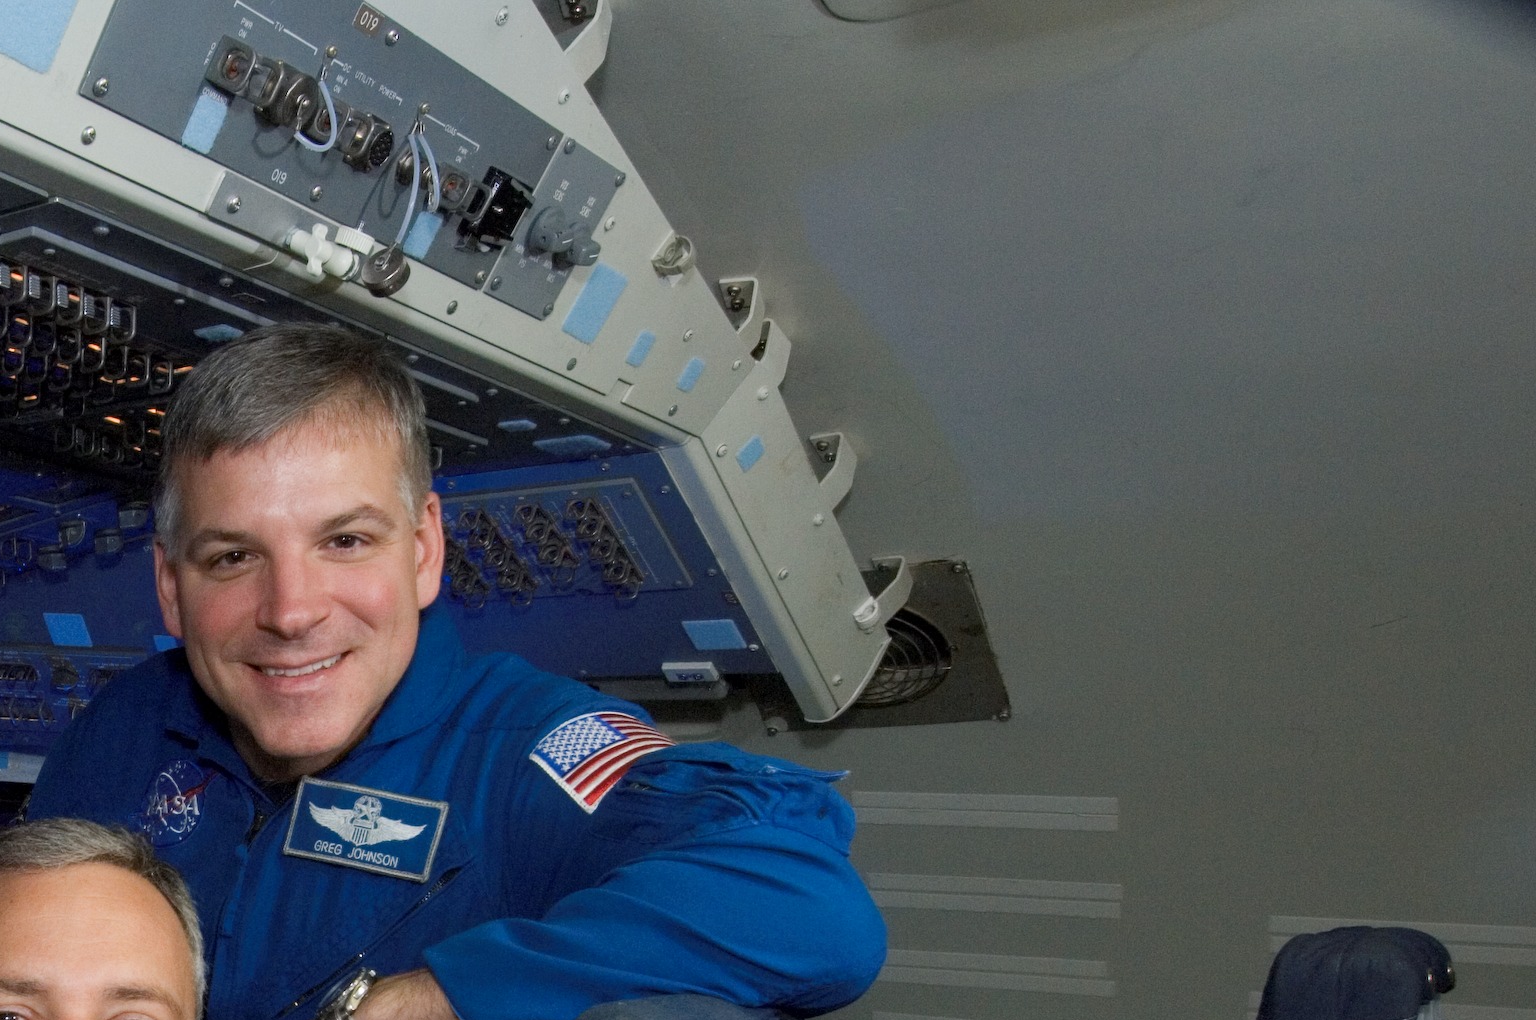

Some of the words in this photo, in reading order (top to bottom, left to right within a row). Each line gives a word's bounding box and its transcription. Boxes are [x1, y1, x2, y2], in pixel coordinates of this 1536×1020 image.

[240, 17, 253, 30] PWR
[274, 21, 284, 32] TV
[238, 29, 246, 38] ON
[342, 63, 351, 73] DC
[355, 71, 376, 87] UTILITY
[379, 85, 396, 100] POWER
[333, 84, 340, 94] ON
[146, 794, 200, 816] NASA
[314, 840, 342, 855] GREG
[347, 847, 398, 868] JOHNSON
